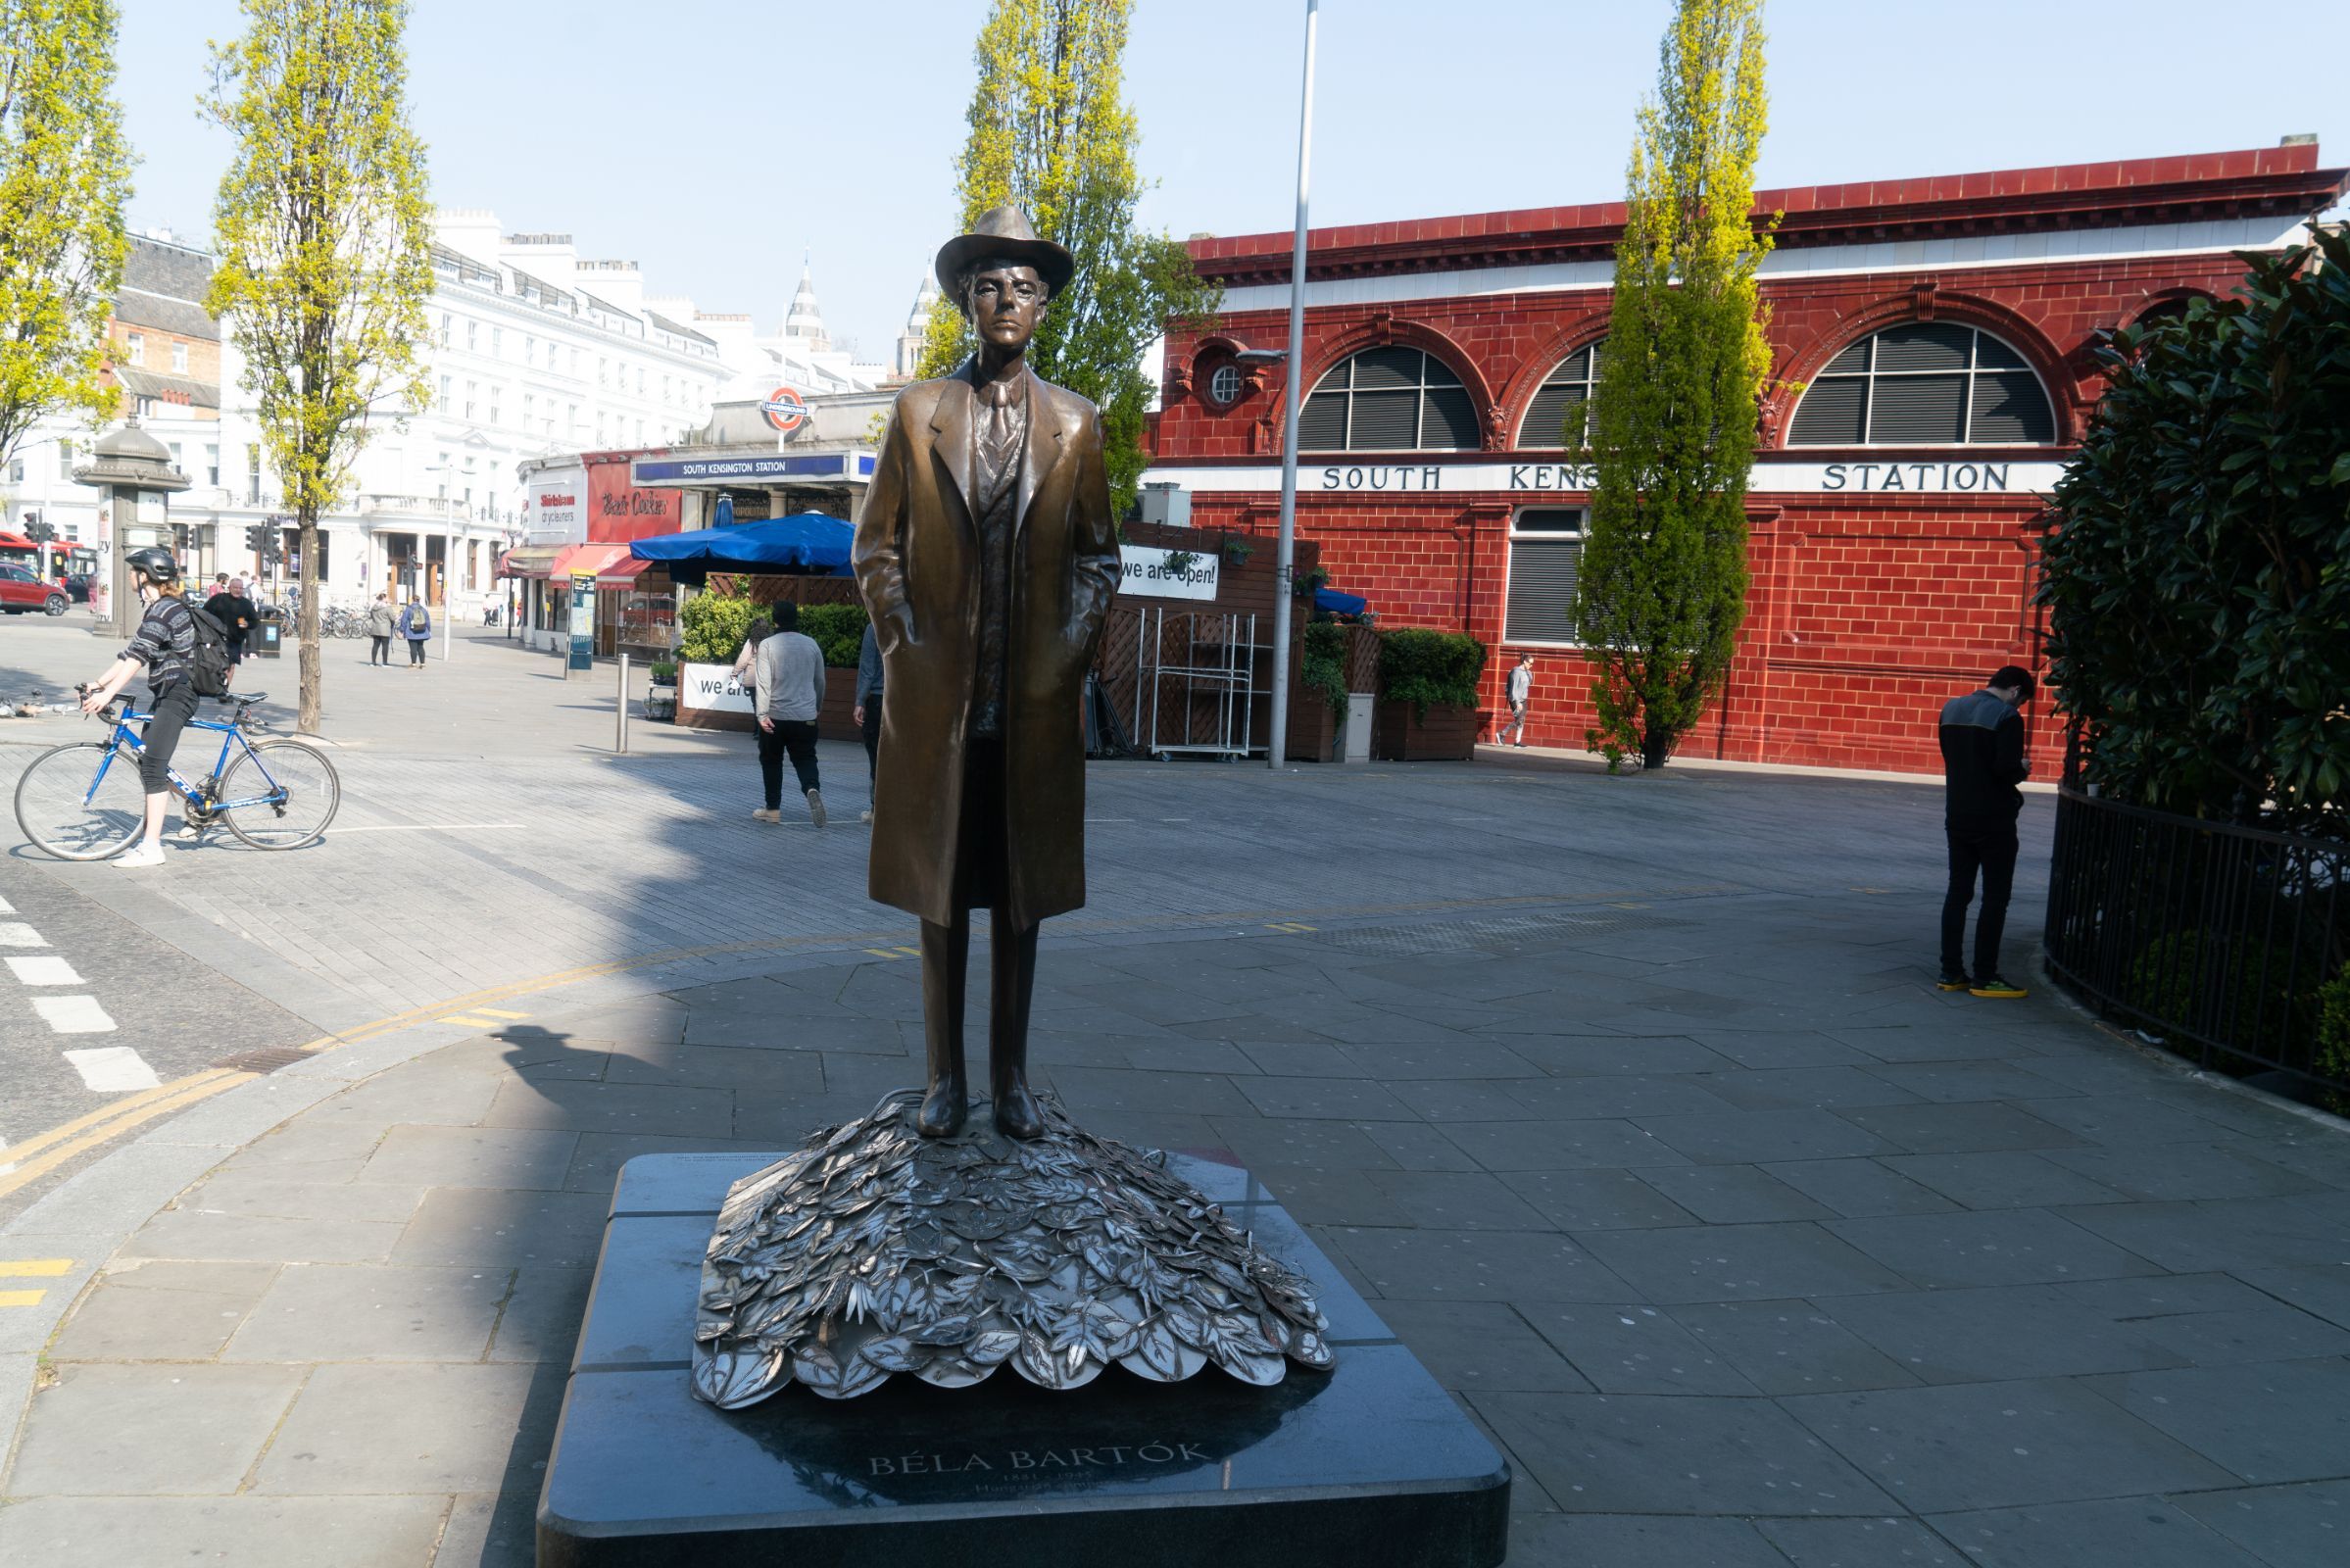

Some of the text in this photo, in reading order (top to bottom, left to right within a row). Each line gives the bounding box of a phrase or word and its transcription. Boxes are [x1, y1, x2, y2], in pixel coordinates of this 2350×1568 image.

[765, 403, 807, 414] UNDERGROUND
[683, 462, 786, 474] SOUTH KENSINGTON STATION
[1323, 465, 2009, 490] SOUTH STATION
[631, 490, 668, 515] Cookies
[541, 512, 574, 525] drycleaners
[1121, 563, 1143, 577] we
[1148, 564, 1172, 580] are
[701, 680, 722, 694] we
[870, 1441, 1212, 1476] BÉLA BARTÓK
